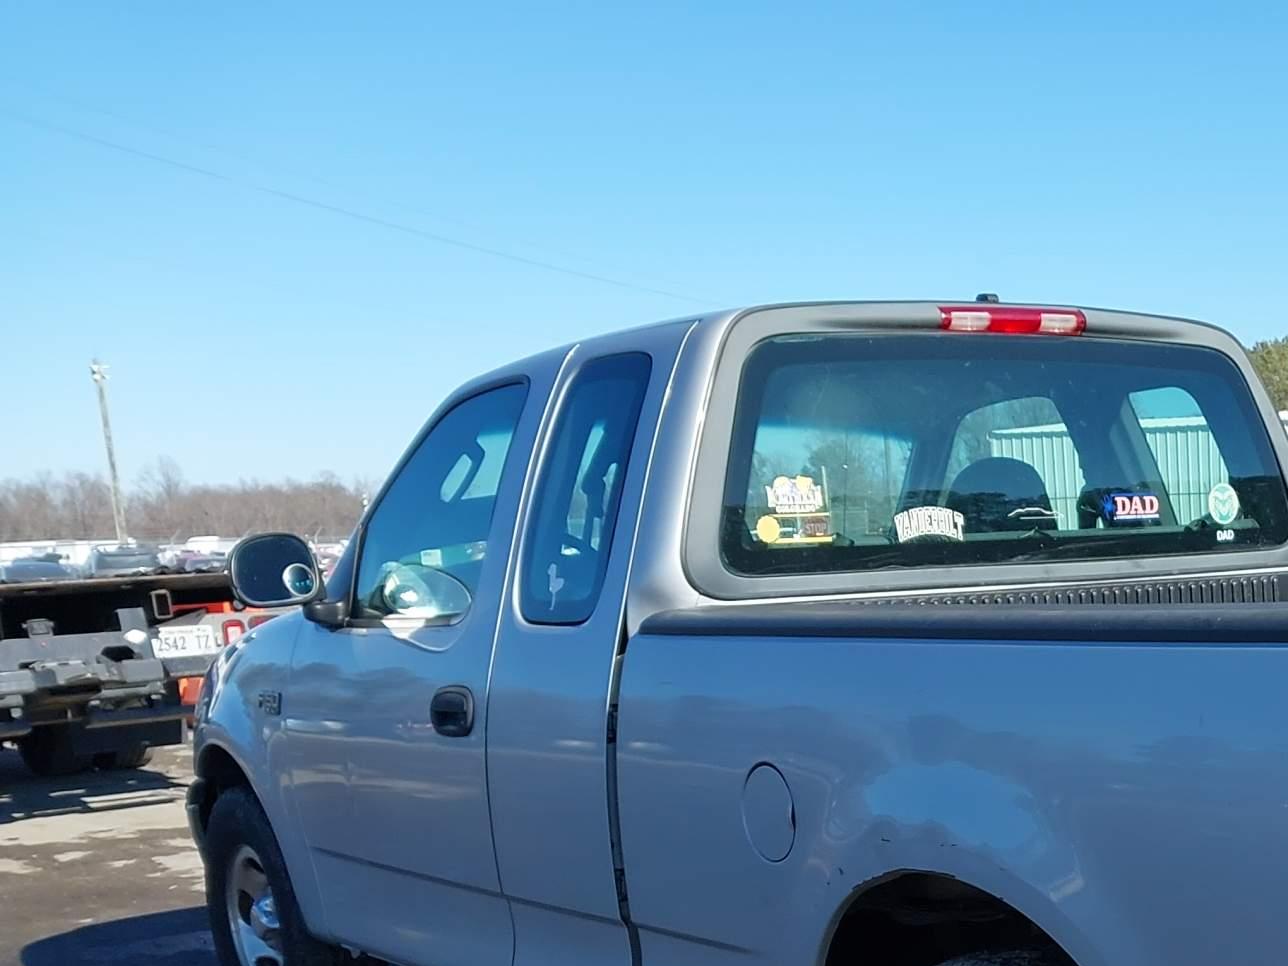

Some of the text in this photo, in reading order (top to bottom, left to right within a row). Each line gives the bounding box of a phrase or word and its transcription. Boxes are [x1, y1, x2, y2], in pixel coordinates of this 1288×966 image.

[1114, 495, 1159, 515] DAD
[894, 506, 965, 543] VANDERBILT
[1216, 529, 1235, 541] DAD
[158, 635, 187, 652] 2542
